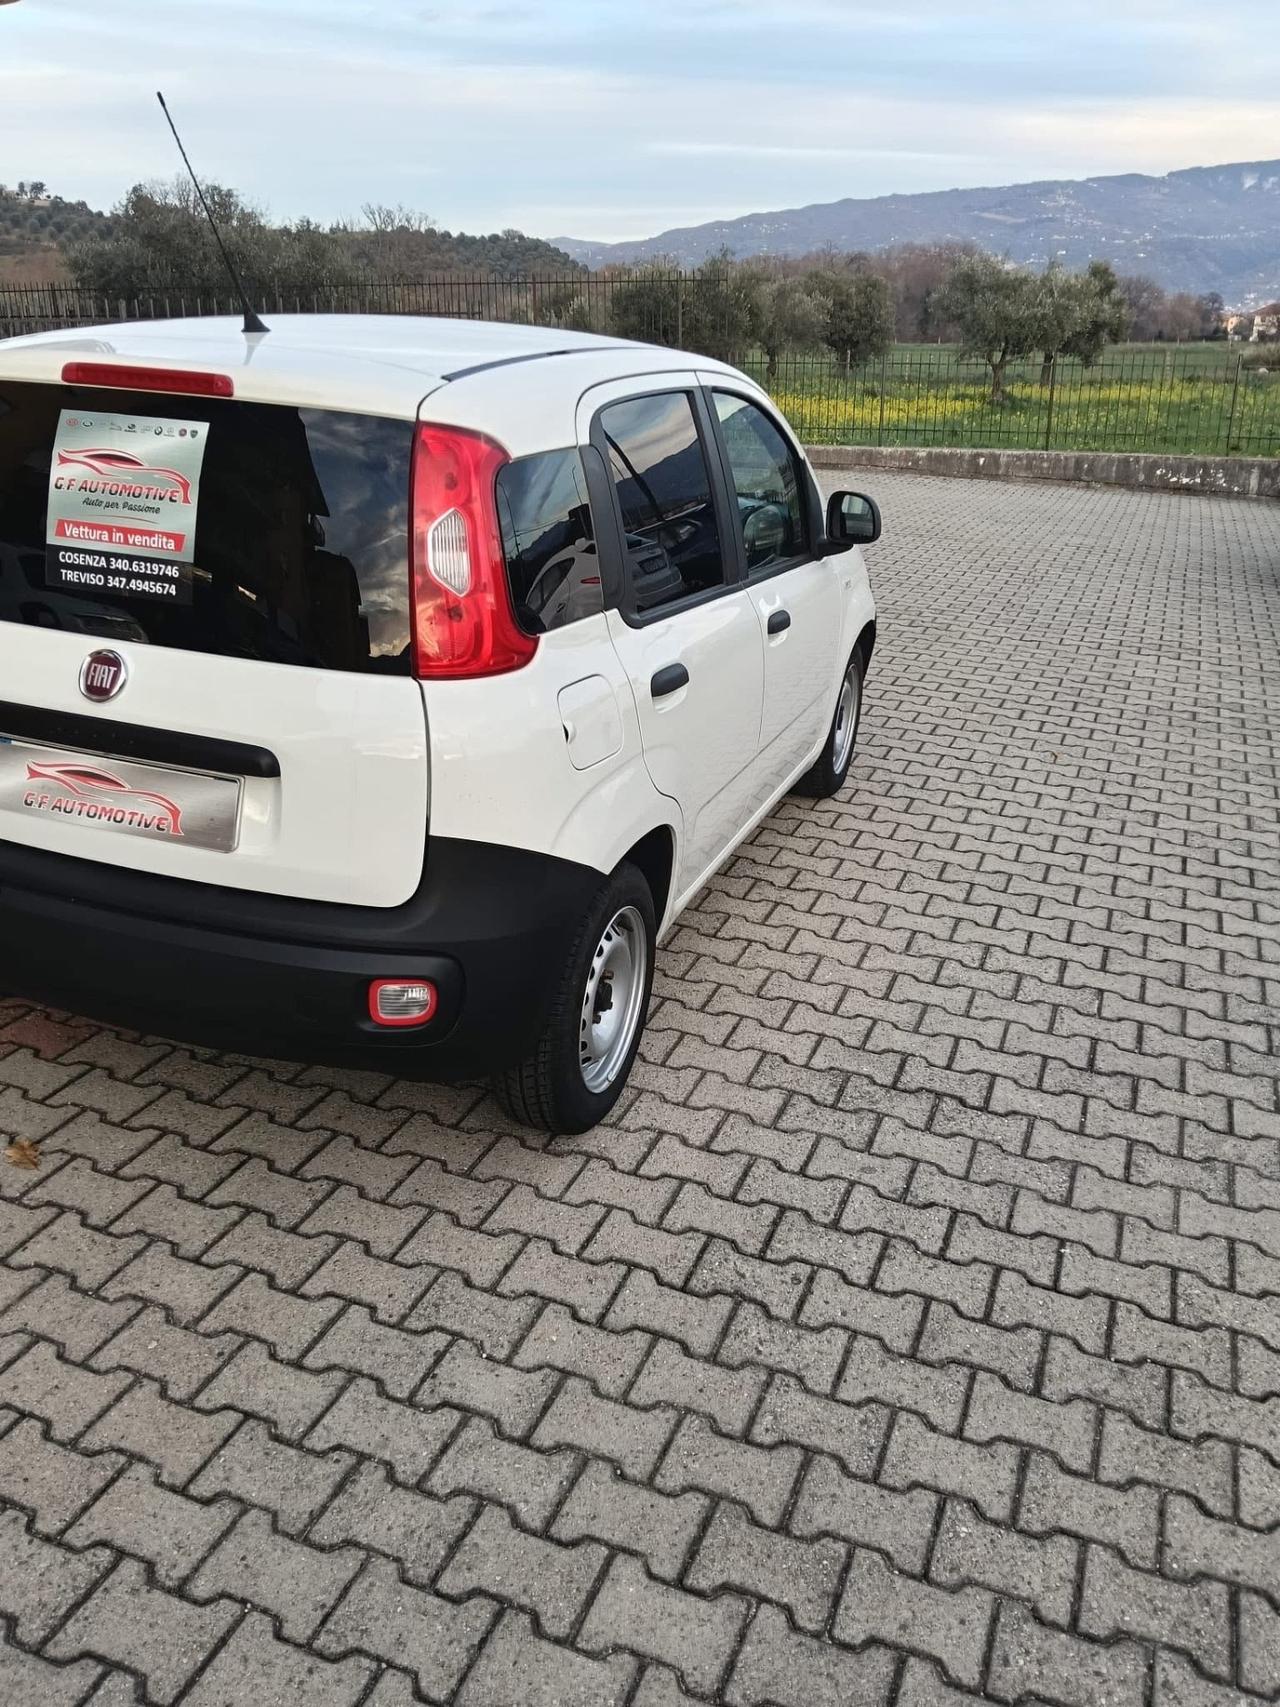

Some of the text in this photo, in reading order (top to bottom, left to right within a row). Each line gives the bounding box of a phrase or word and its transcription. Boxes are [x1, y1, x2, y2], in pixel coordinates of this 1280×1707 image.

[78, 480, 180, 503] AUTOMOTIVE
[82, 497, 160, 514] Auto per Passione
[64, 522, 175, 550] Vettura in vendita
[58, 551, 180, 578] COSENZA 340.6319746
[60, 569, 176, 596] TREVISO 347.4945674
[87, 663, 117, 689] FIAT
[51, 797, 169, 832] AUTOMOTIVE
